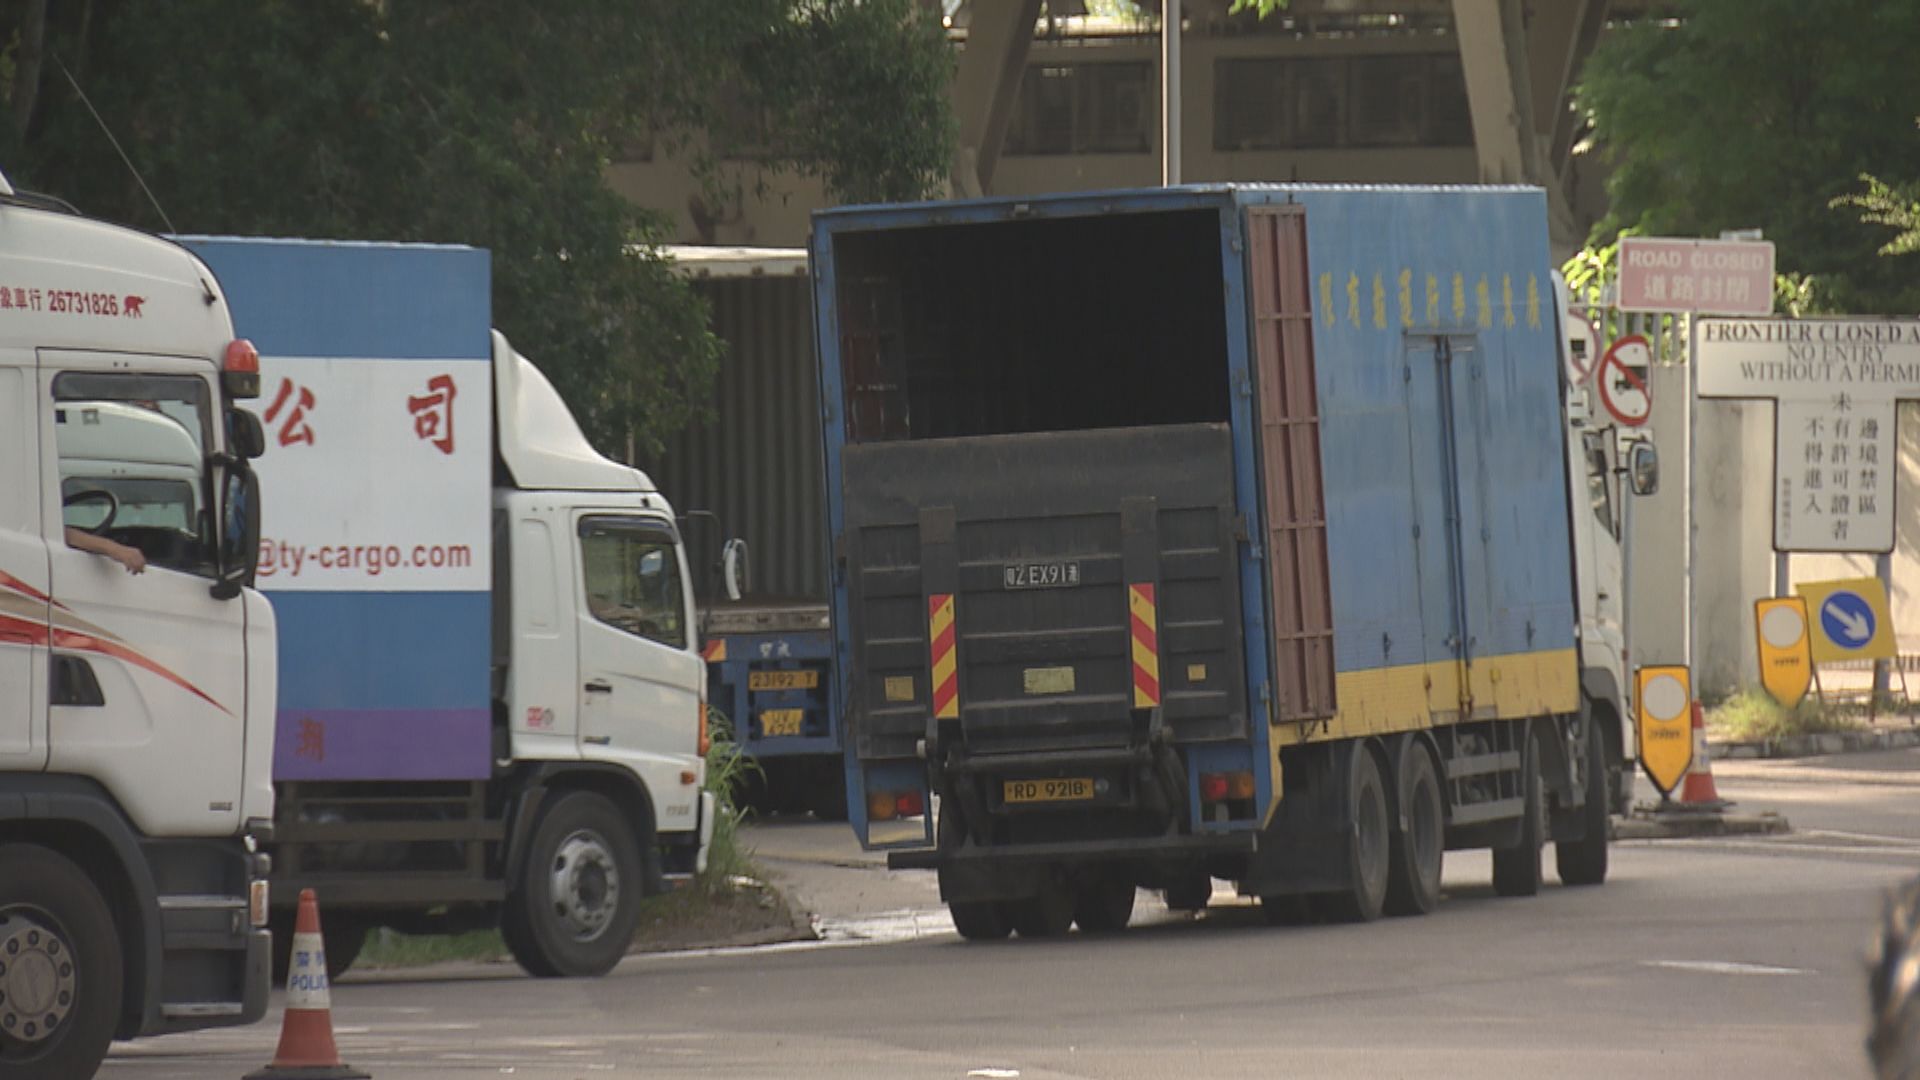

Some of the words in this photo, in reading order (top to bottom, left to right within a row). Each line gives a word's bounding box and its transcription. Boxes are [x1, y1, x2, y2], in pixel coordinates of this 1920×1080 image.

[1629, 250, 1683, 269] ROAD
[1691, 251, 1765, 271] CLOSED
[47, 290, 119, 316] 26731826
[1705, 322, 1812, 344] FRONTIER
[1820, 323, 1902, 345] CLOSED
[1788, 343, 1817, 362] NO
[1823, 344, 1887, 363] ENTRY
[1740, 361, 1835, 382] WITHOUT
[1838, 362, 1854, 382] A
[264, 374, 457, 455] 公司
[1803, 417, 1825, 515] 不得進入
[256, 539, 471, 576] @ty-cargo.com
[1013, 783, 1037, 799] RD
